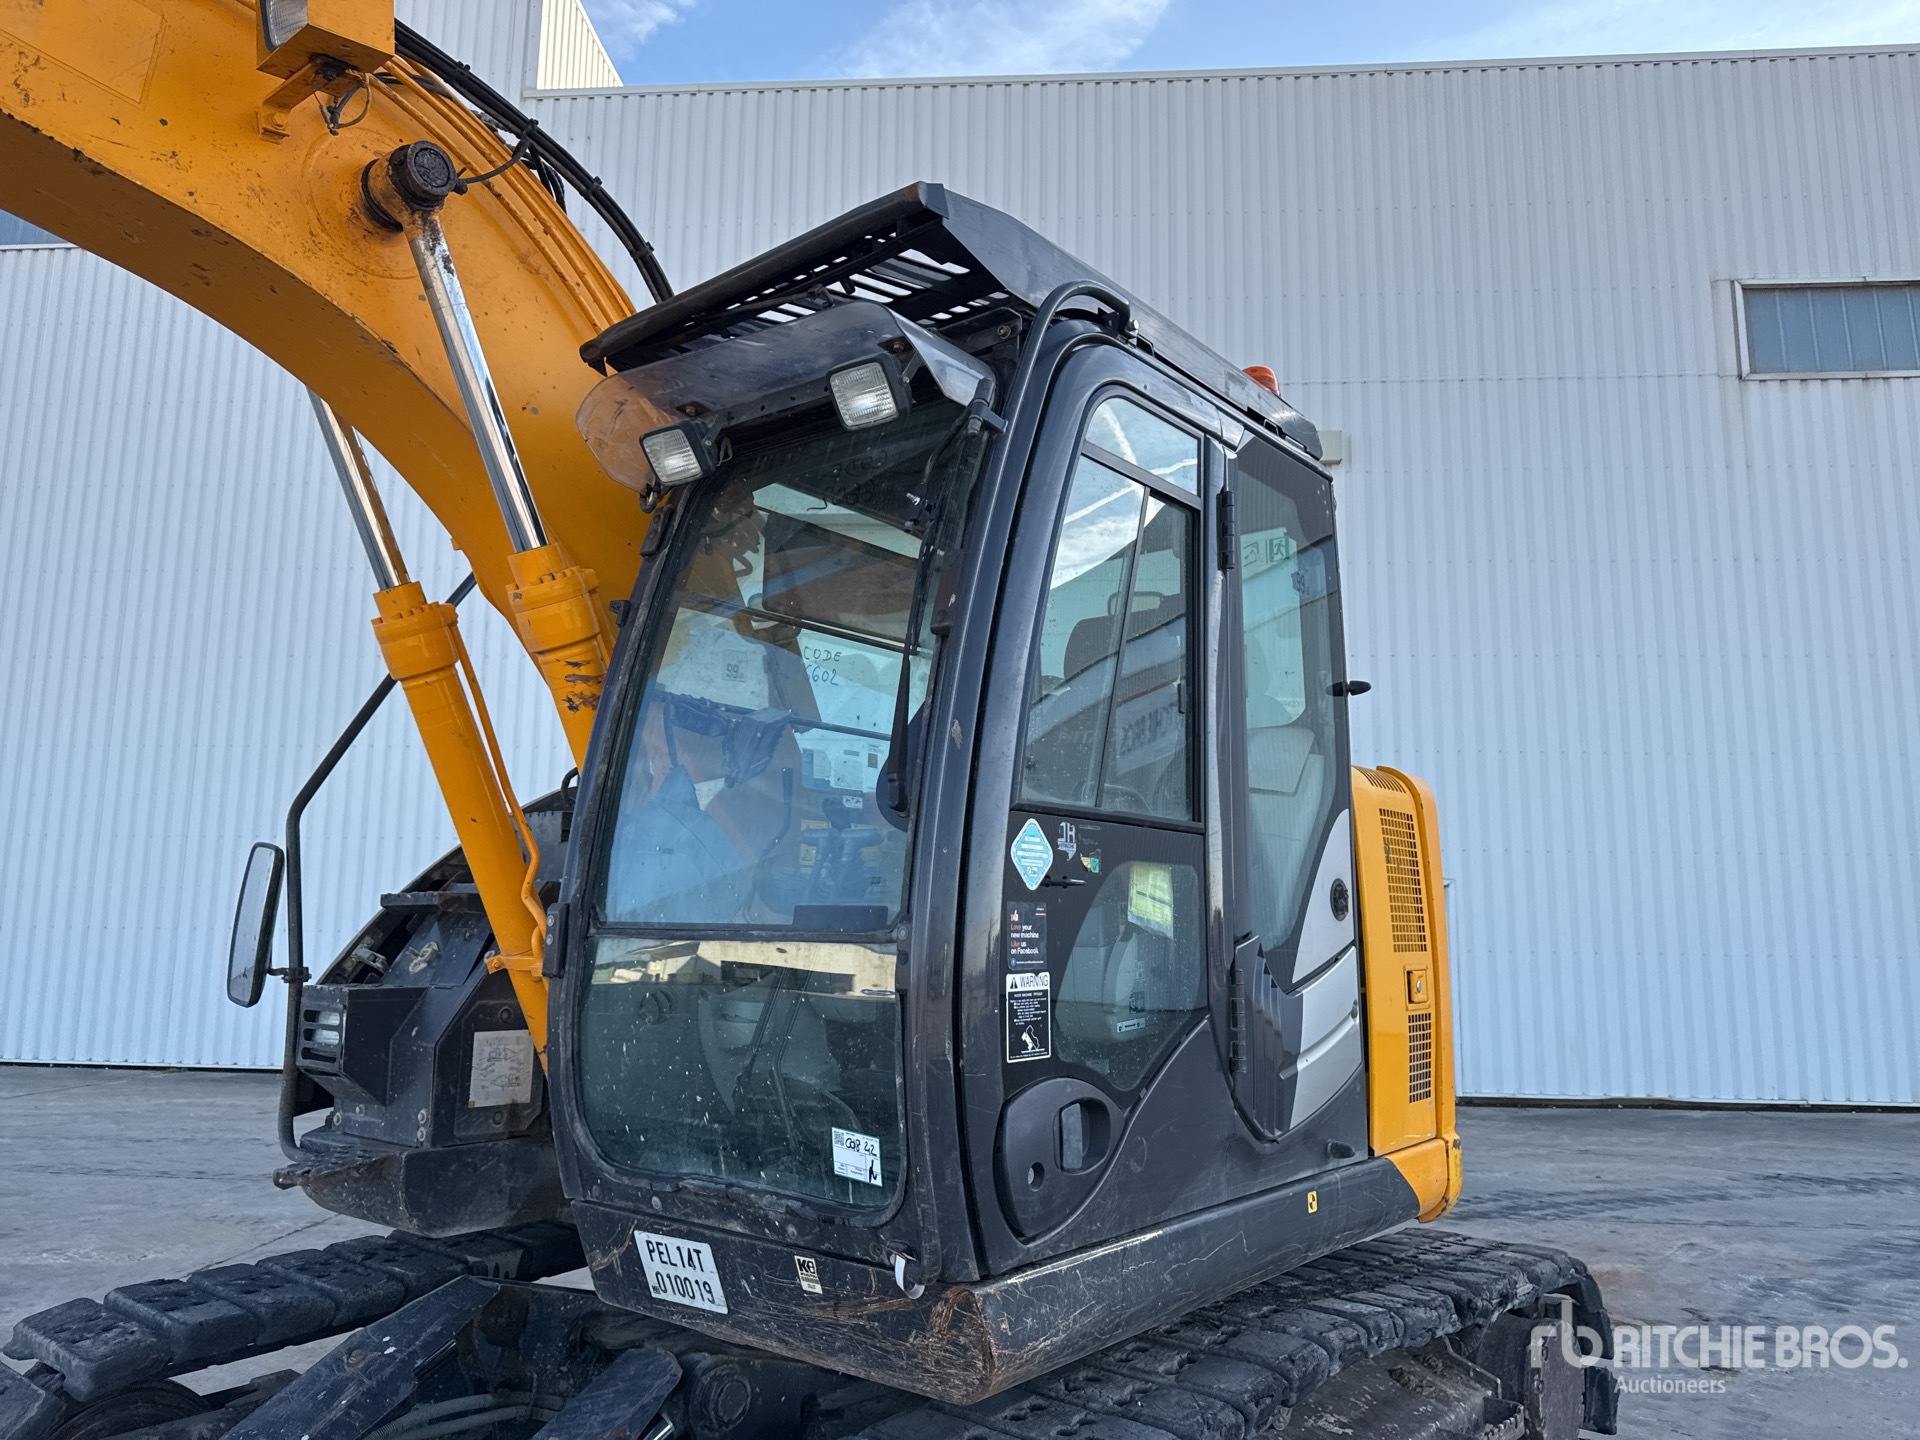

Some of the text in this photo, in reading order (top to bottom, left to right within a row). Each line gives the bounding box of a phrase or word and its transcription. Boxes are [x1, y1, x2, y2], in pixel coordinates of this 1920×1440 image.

[803, 646, 842, 662] CODE
[1020, 975, 1048, 988] WARNING
[655, 1271, 715, 1304] 010019
